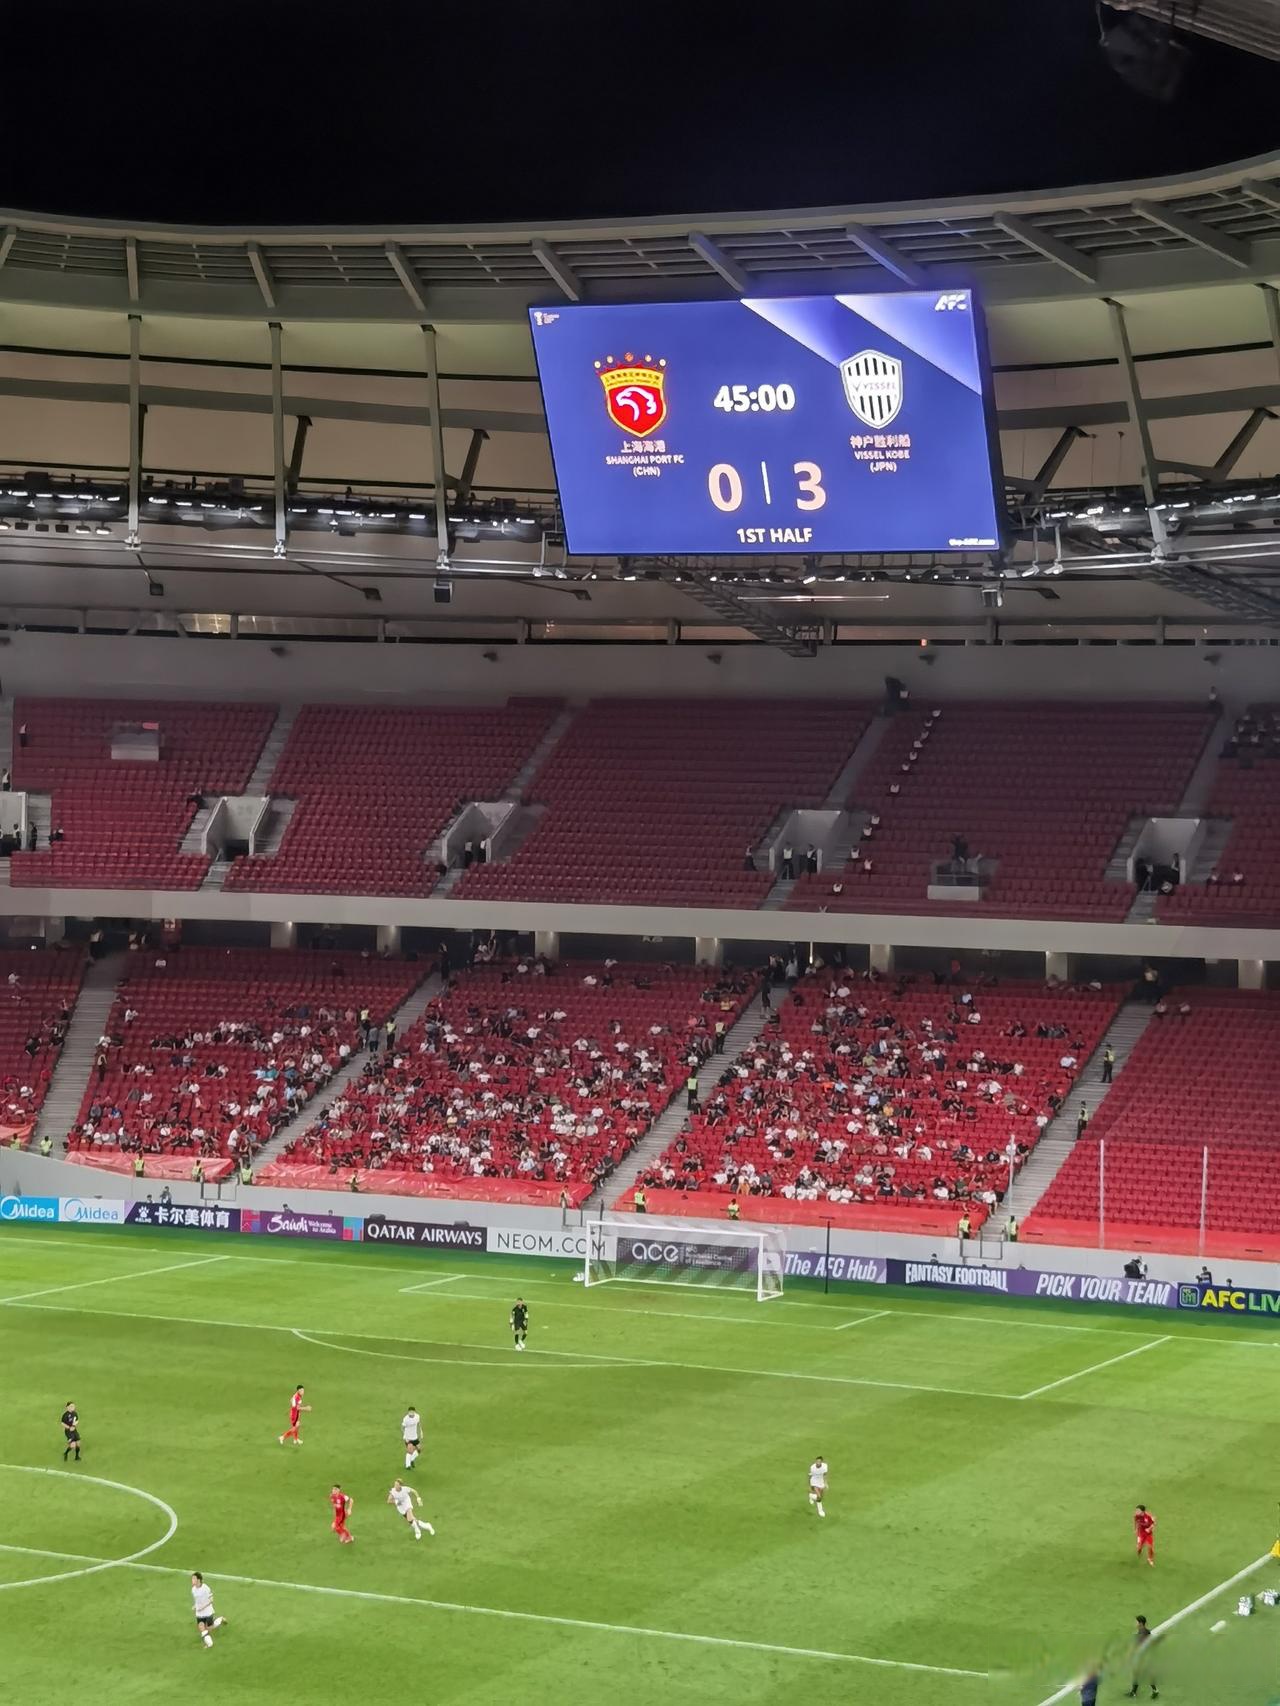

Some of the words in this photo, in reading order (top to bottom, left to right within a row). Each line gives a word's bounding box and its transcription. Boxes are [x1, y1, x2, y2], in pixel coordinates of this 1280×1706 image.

[934, 295, 966, 310] AFC
[713, 384, 796, 412] 45:00
[605, 455, 649, 465] SHANGHAI
[649, 454, 672, 464] PORT
[673, 454, 684, 464] FC
[854, 450, 885, 460] VISSEL
[885, 449, 910, 459] KOBE
[632, 466, 661, 478] (CHN)
[870, 461, 897, 473] (JPN)
[708, 463, 743, 512] 0
[793, 461, 827, 511] 3
[737, 528, 766, 543] 1ST
[769, 527, 813, 543] HALF
[9, 1200, 55, 1219] Midea
[74, 1205, 119, 1222] Midea
[154, 1206, 231, 1229] 卡尔美体育
[267, 1214, 309, 1233] Saudi
[367, 1223, 415, 1240] QATAR
[421, 1227, 482, 1246] AIRWAYS
[632, 1242, 679, 1262] ace
[785, 1253, 810, 1274] The
[814, 1257, 844, 1279] AFC
[848, 1259, 877, 1281] Hub
[905, 1263, 953, 1284] FANTASY
[955, 1267, 1008, 1292] FOOTBALL
[1035, 1273, 1072, 1296] PICK
[1079, 1277, 1121, 1301] YOUR
[1126, 1281, 1171, 1306] TEAM
[1201, 1289, 1245, 1310] AFC
